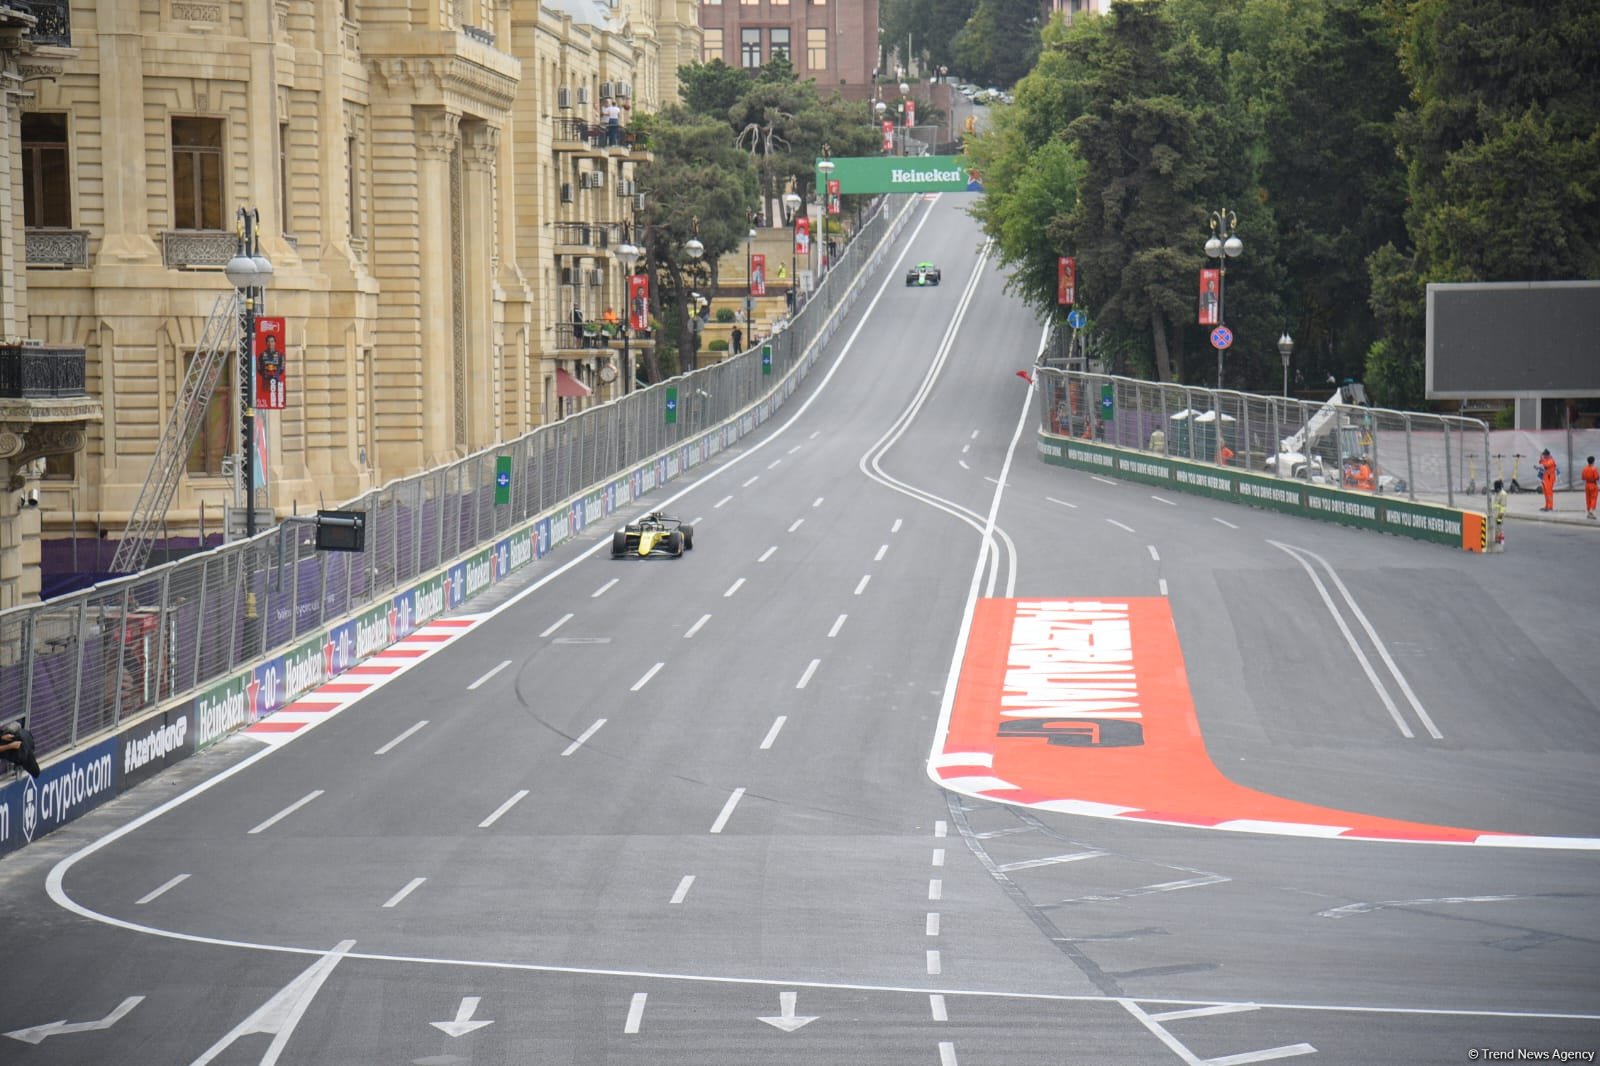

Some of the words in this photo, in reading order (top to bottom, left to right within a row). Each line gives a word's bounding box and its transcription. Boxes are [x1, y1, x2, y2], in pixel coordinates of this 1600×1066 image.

[892, 169, 960, 183] Heineken
[1308, 495, 1321, 509] WHEN
[1321, 497, 1331, 511] YOU
[1331, 499, 1345, 514] DRIVE
[1345, 502, 1360, 517] NEVER
[1360, 504, 1376, 520] DRINK
[1386, 509, 1401, 524] WHEN
[1401, 511, 1411, 526] YOU
[1412, 513, 1427, 529] DRIVE
[1427, 516, 1444, 532] NEVER
[1444, 519, 1461, 535] DRINK
[414, 583, 442, 625] Heineken
[356, 613, 387, 659] Heineken
[285, 648, 321, 699] Heineken
[199, 687, 245, 746] Heineken
[41, 753, 112, 823] crypto.com
